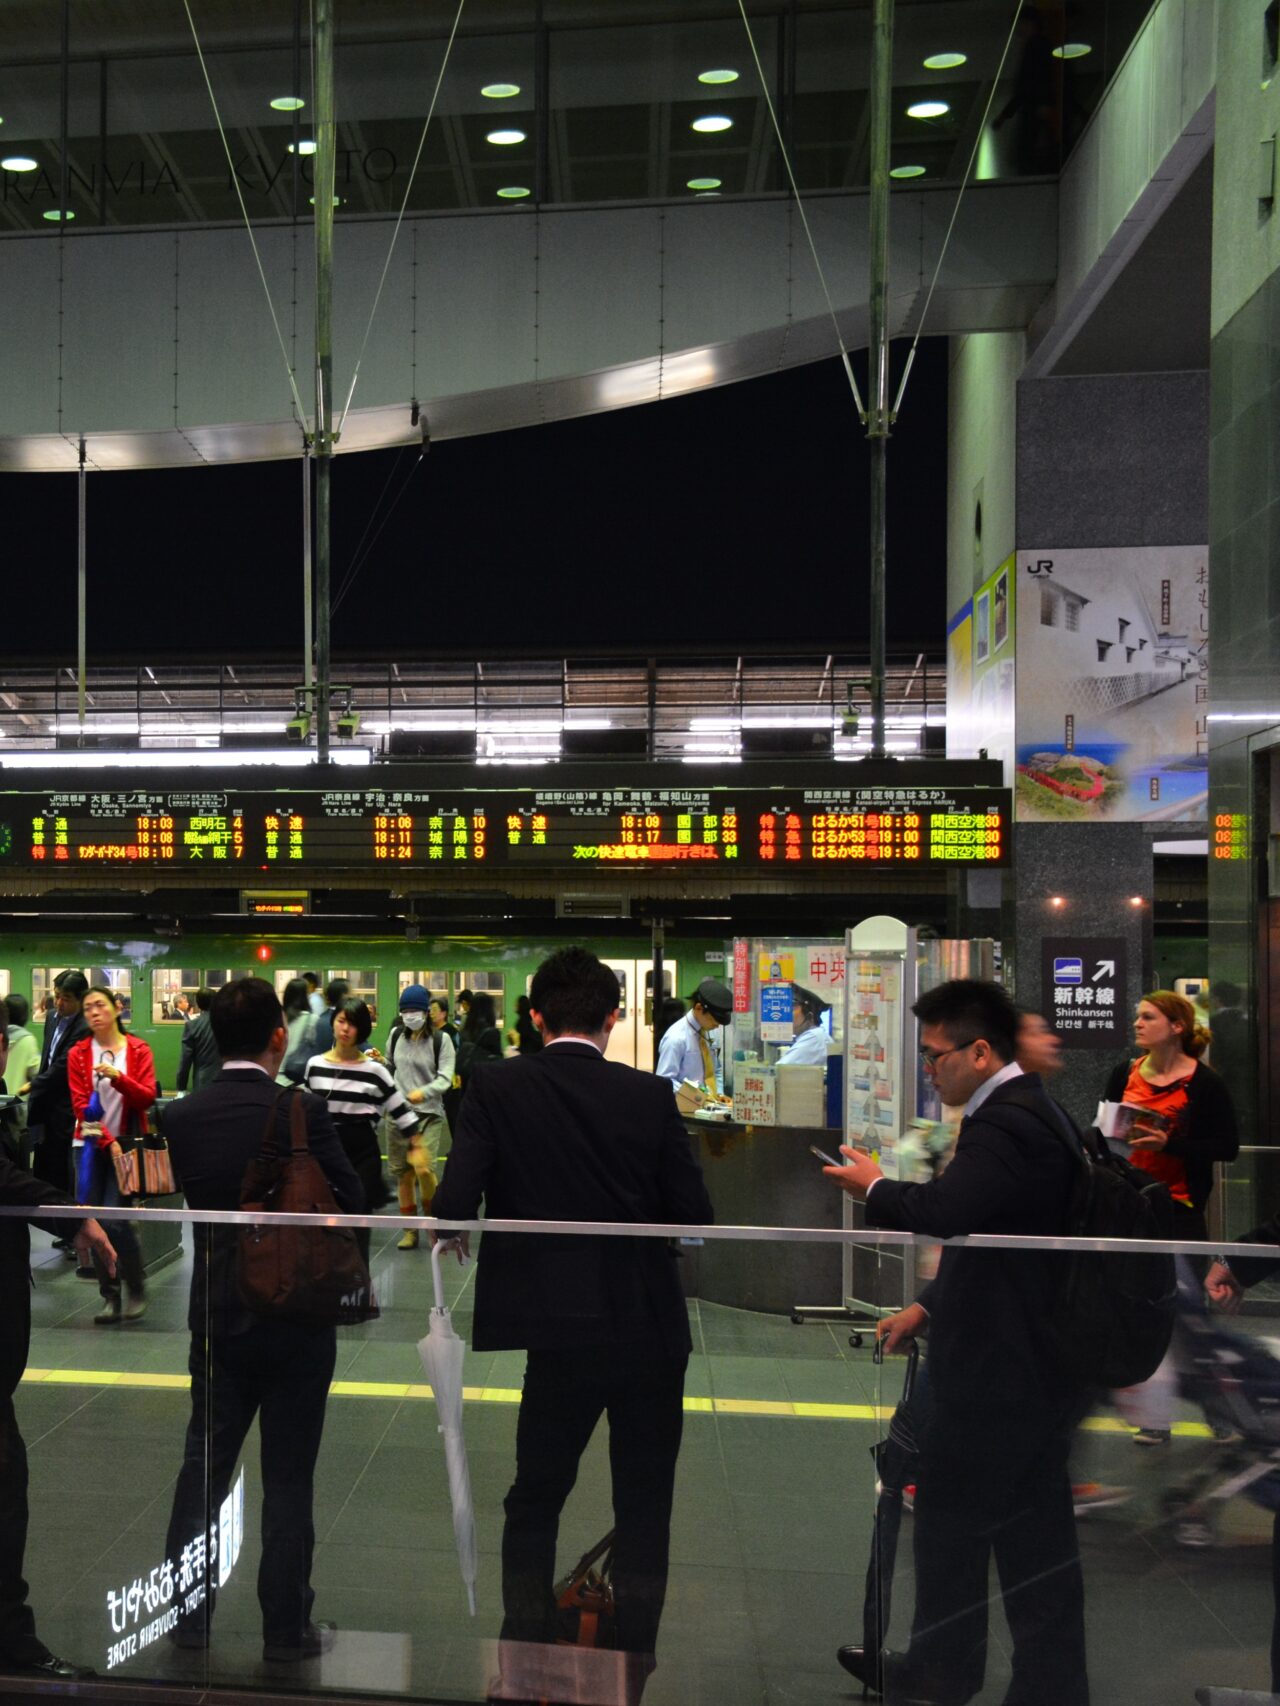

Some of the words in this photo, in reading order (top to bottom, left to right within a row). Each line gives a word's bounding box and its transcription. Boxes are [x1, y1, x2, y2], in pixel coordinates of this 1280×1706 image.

[1027, 560, 1053, 574] JR
[33, 818, 67, 830] 普通
[138, 817, 172, 829] 18:03
[191, 818, 226, 829] 西明石
[234, 817, 242, 828] 4
[266, 816, 302, 829] 快速
[430, 817, 466, 829] 奈良
[473, 817, 485, 828] 10
[508, 816, 546, 829] 快速
[621, 817, 660, 830] 18:09
[723, 817, 736, 830] 32
[760, 816, 800, 829] 特急
[813, 815, 879, 828] はるか51号
[878, 815, 919, 828] 18:30
[931, 815, 986, 828] 関西空港
[985, 815, 1000, 827] 30
[33, 832, 67, 844] 普通
[138, 832, 173, 843] 18:08
[234, 831, 242, 843] 5
[266, 831, 302, 843] 普通
[375, 831, 410, 843] 18:11
[430, 831, 467, 843] 城陽
[474, 831, 484, 843] 9
[508, 831, 545, 843] 普通
[621, 831, 660, 844] 18:17
[722, 830, 736, 842] 33
[760, 831, 800, 844] 特急
[812, 830, 879, 843] はるか53号
[878, 830, 919, 843] 19:00
[931, 830, 986, 843] 関西空港
[985, 830, 1000, 843] 30
[32, 846, 68, 859] 特急
[137, 846, 173, 857] 18:10
[191, 846, 226, 858] 大阪
[235, 846, 242, 857] 7
[266, 846, 302, 858] 普通
[375, 846, 411, 858] 18:24
[430, 846, 466, 858] 奈良
[474, 846, 484, 858] 9
[760, 845, 800, 858] 特急
[812, 845, 879, 858] はるか55号
[878, 845, 919, 858] 19:30
[931, 845, 986, 858] 関西空港
[985, 845, 1000, 858] 30
[734, 943, 747, 1011] 特別警戒中
[1054, 987, 1114, 1004] 新幹線
[1055, 1007, 1114, 1018] Shinkansen
[1055, 1020, 1082, 1029] 신칸센
[1088, 1020, 1114, 1029] 新干线
